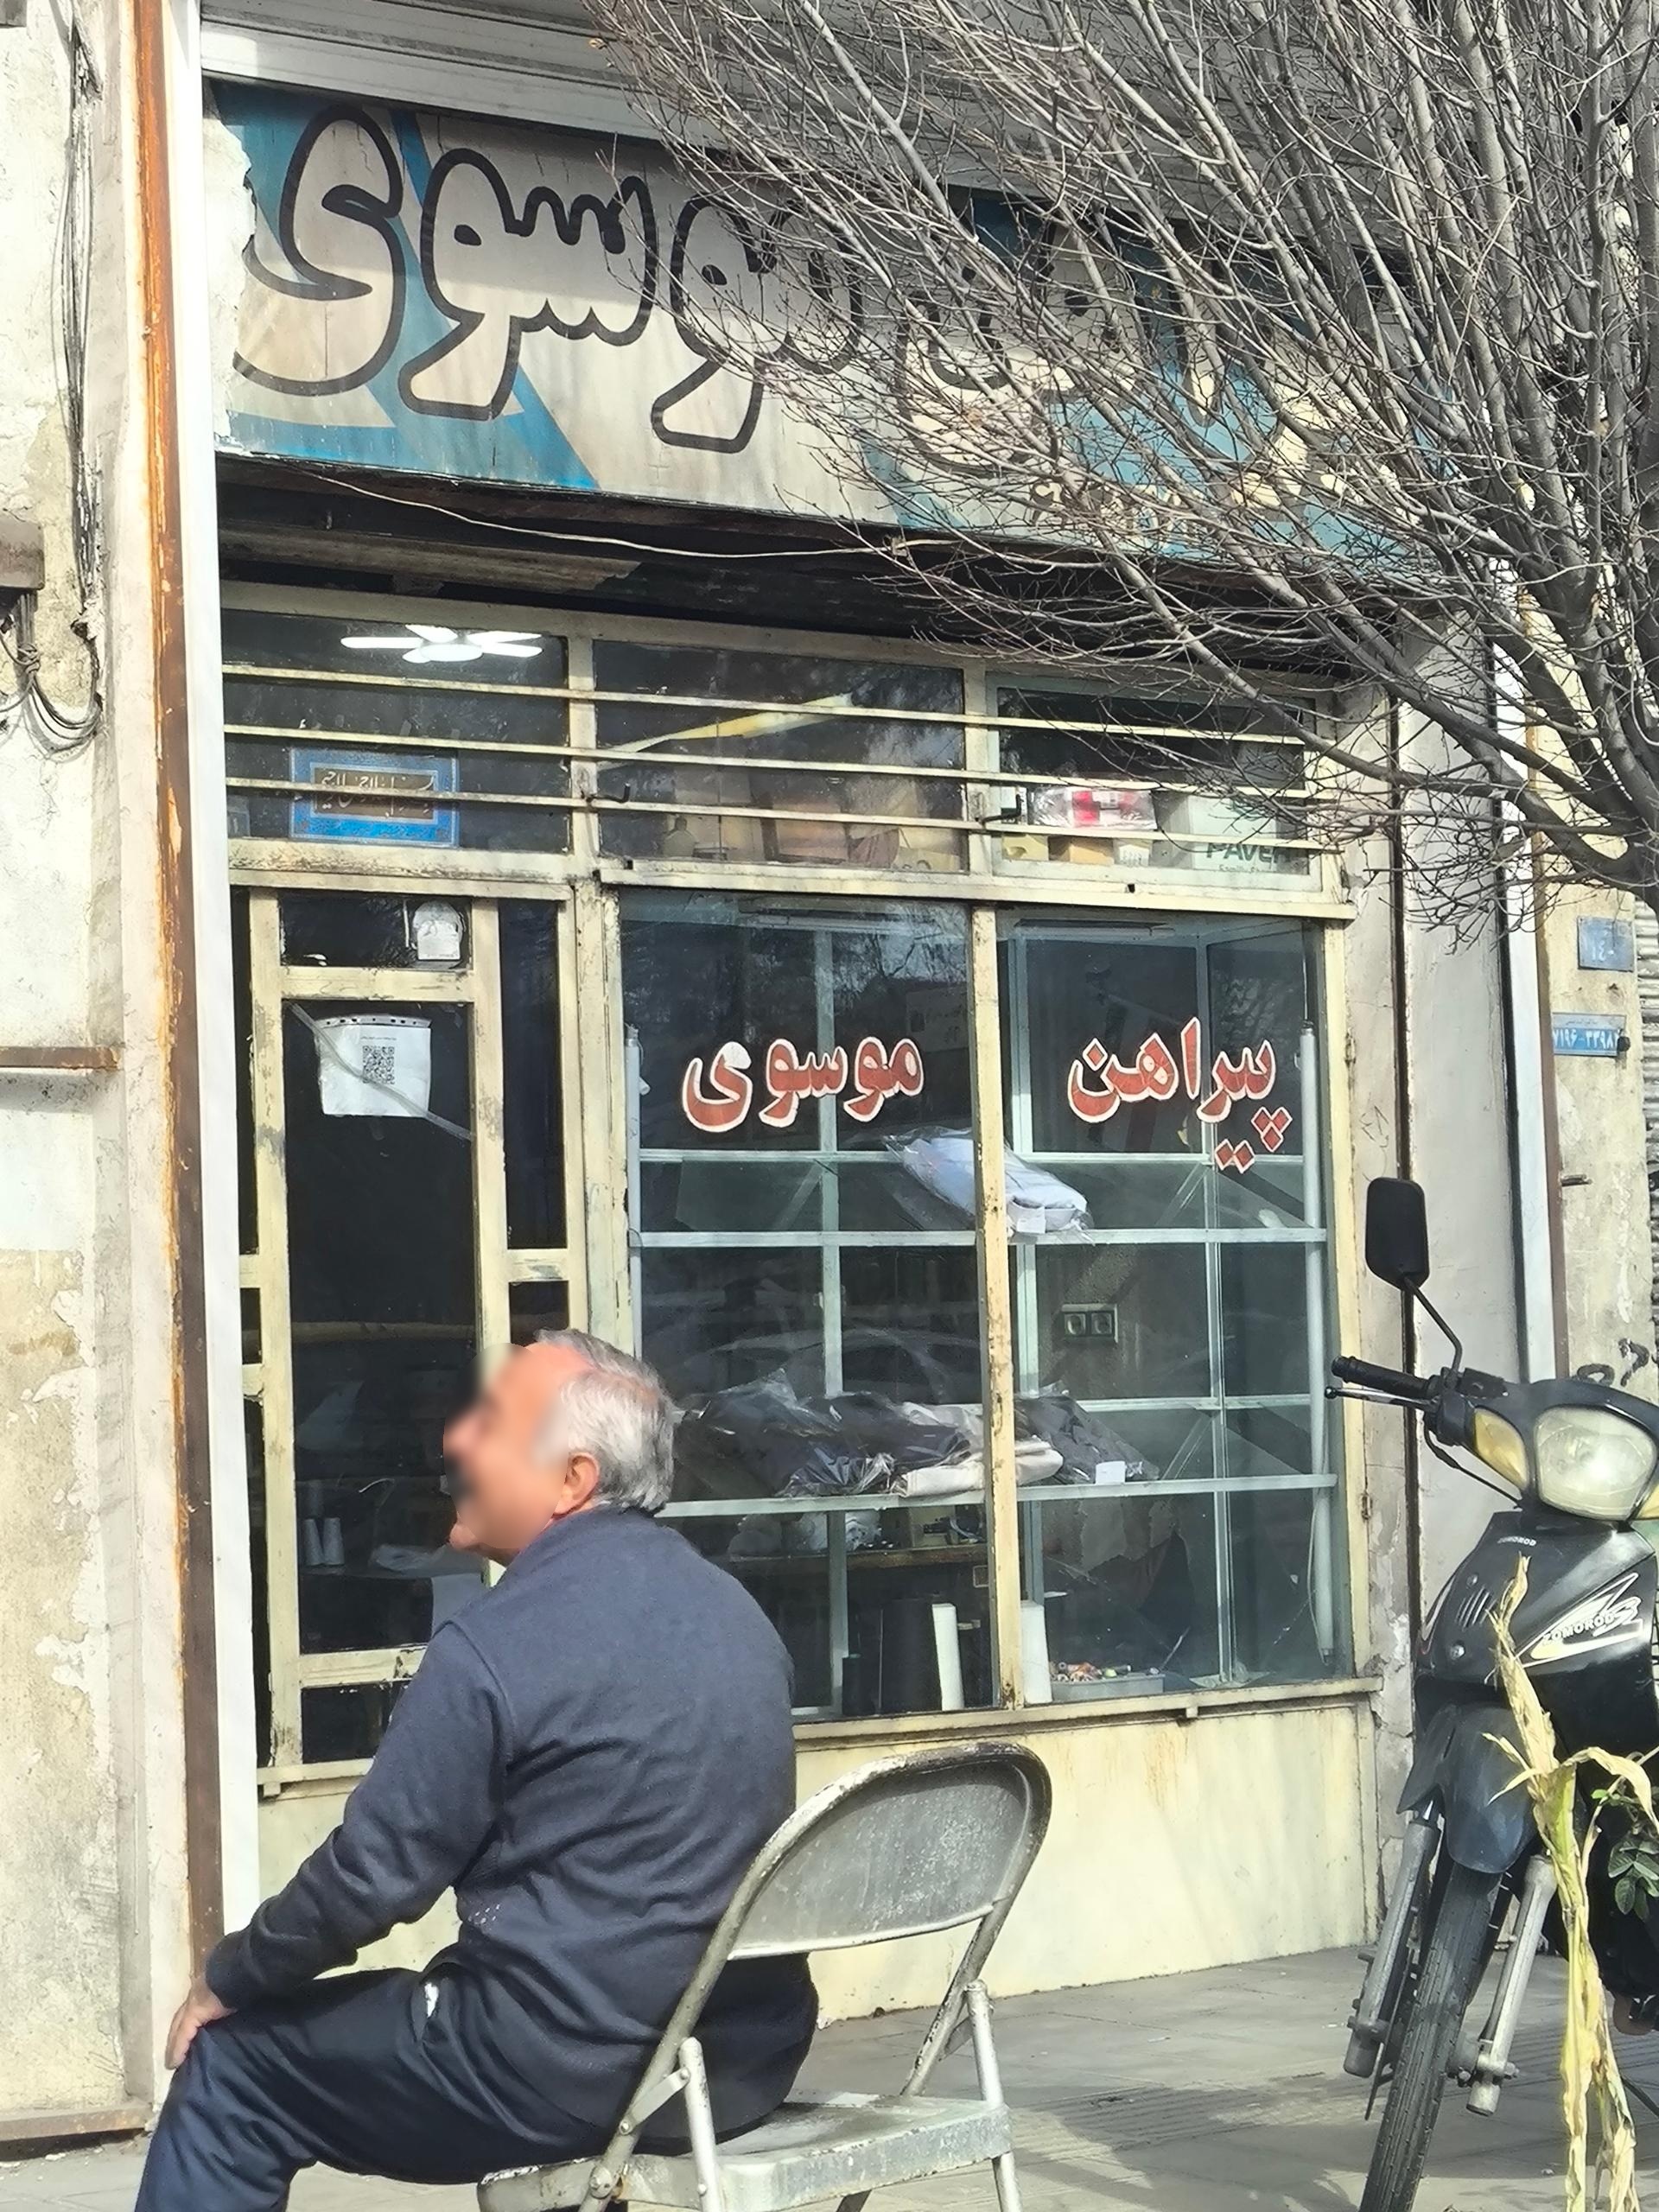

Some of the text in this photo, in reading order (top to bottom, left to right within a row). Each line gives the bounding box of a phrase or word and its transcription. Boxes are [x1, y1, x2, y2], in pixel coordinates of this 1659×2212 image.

[232, 105, 864, 454] موسوی
[683, 1016, 1294, 1174] پیراهن موسوی
[1542, 1611, 1616, 1643] ZOMOROD
